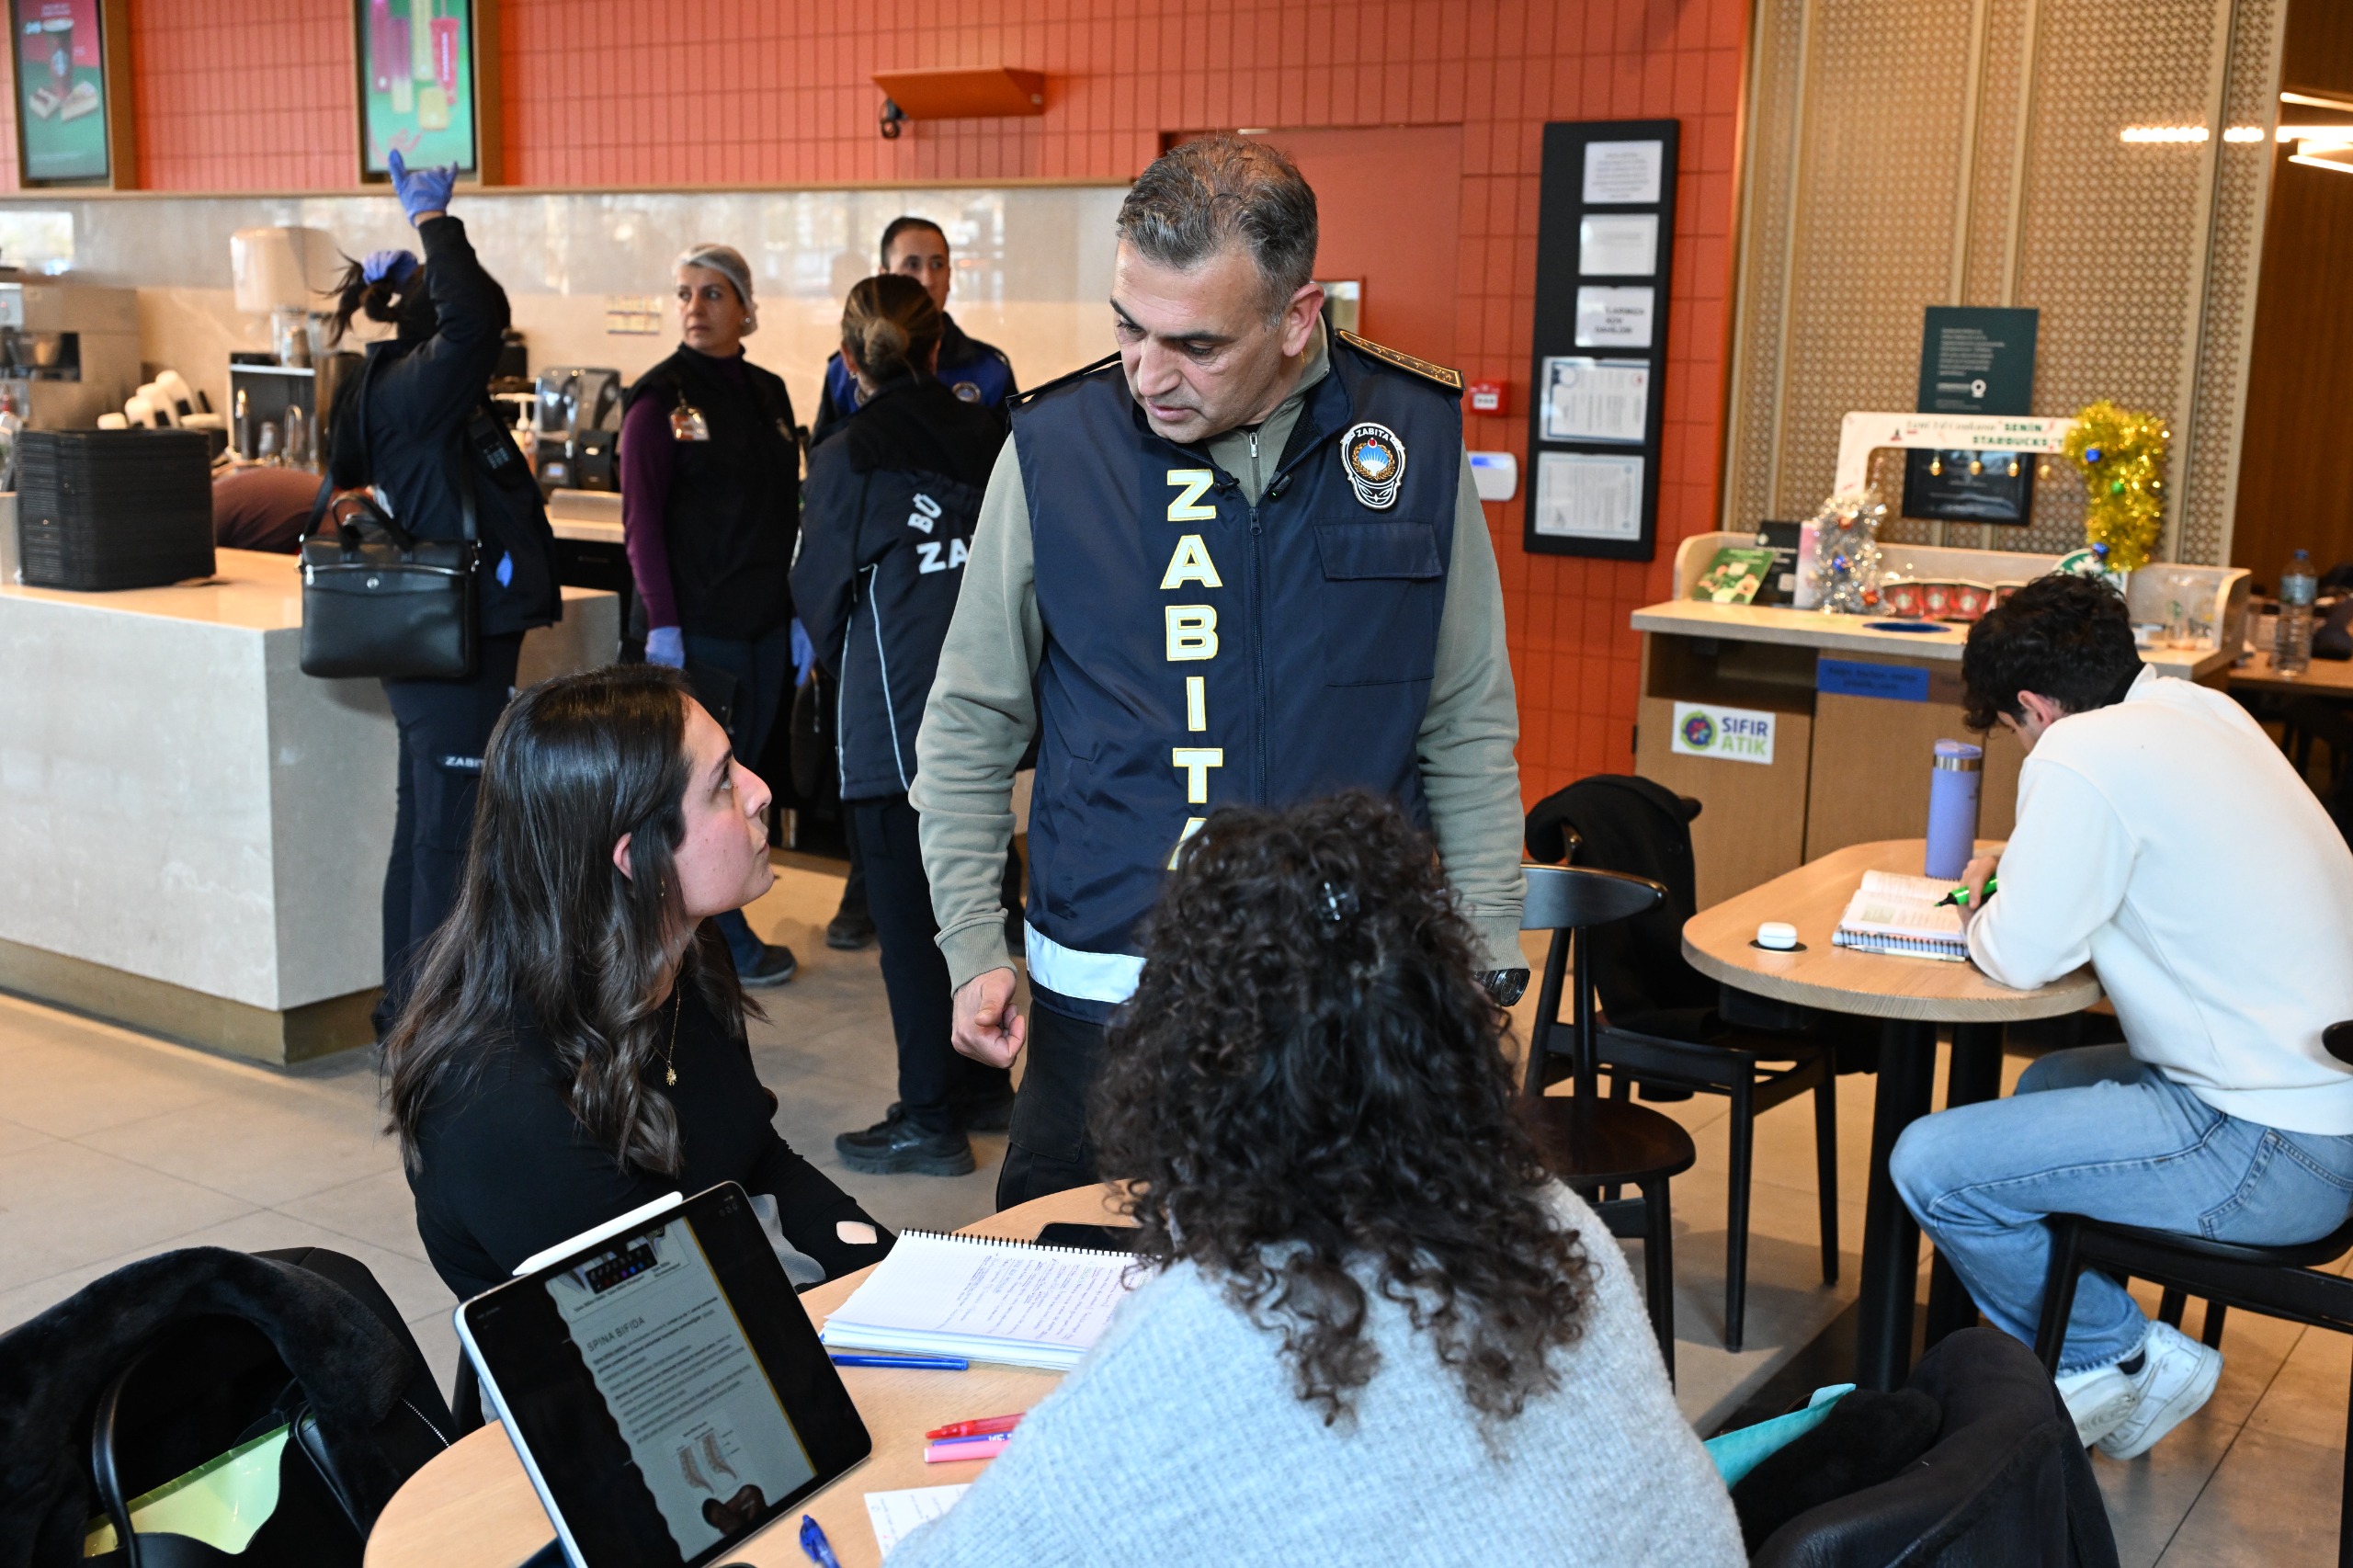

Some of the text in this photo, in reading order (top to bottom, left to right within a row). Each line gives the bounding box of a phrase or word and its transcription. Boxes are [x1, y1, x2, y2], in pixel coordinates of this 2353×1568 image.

[1355, 427, 1390, 441] ZABITA
[1972, 436, 2049, 448] STARBUCKS
[915, 534, 974, 574] ZA
[1722, 716, 1768, 736] SIFIR
[1721, 734, 1767, 756] ATIK
[586, 1316, 645, 1352] SPINA BIFIDA
